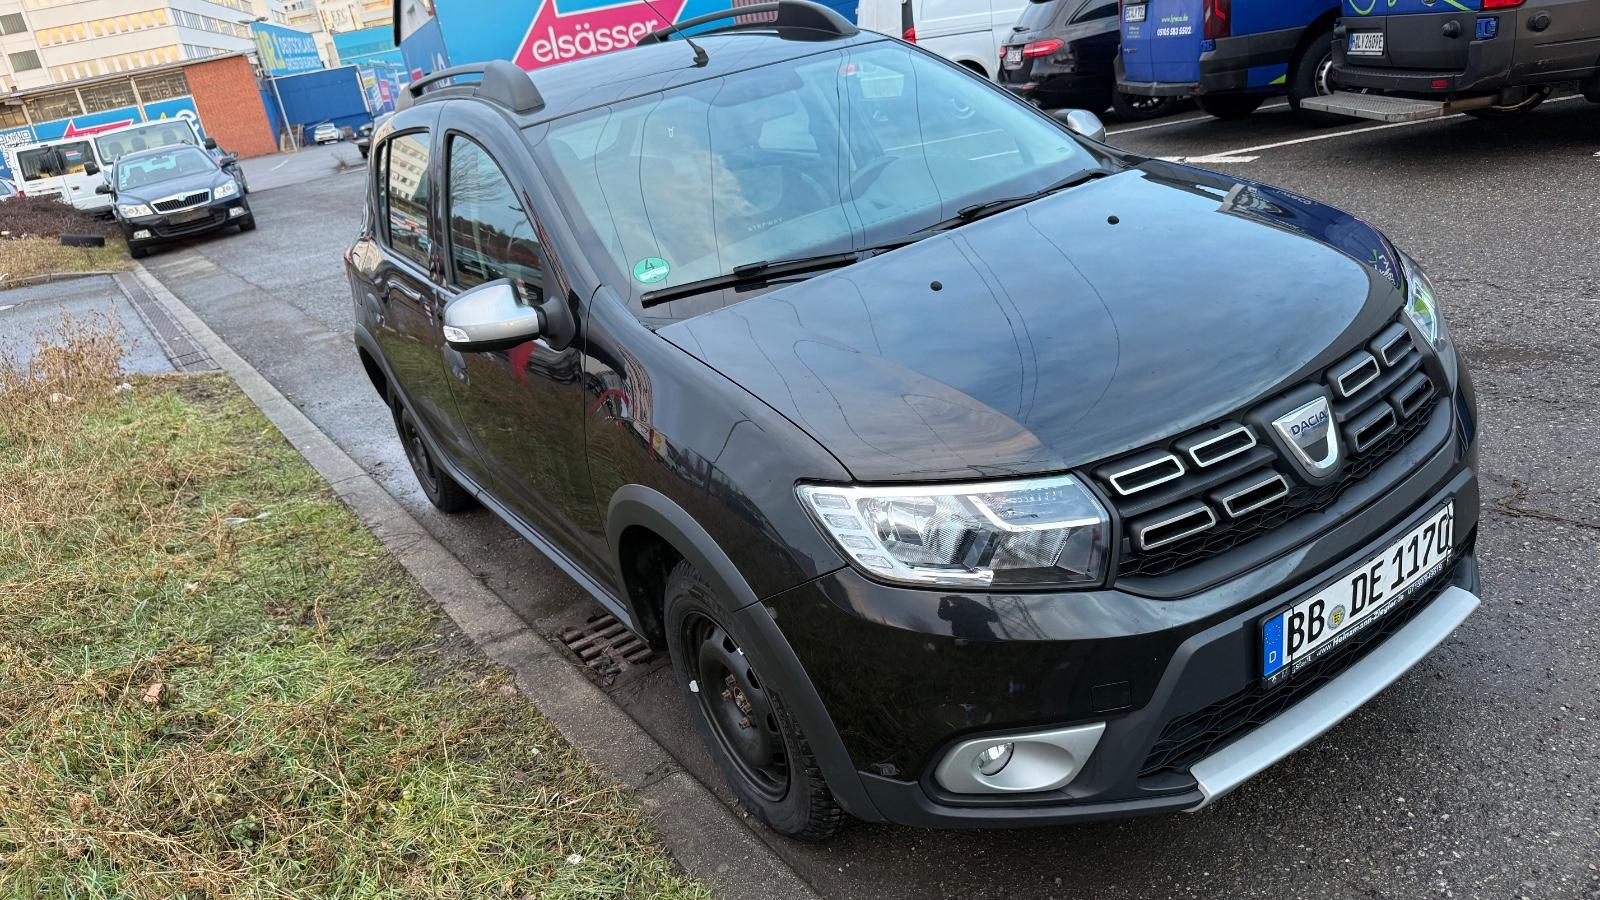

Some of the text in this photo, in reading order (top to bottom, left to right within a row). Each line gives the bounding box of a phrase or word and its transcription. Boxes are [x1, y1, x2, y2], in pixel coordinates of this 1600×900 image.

[532, 19, 659, 62] elsässer
[1290, 410, 1328, 435] DACIA
[1286, 514, 1450, 657] BB DE 1170
[1269, 650, 1277, 664] D
